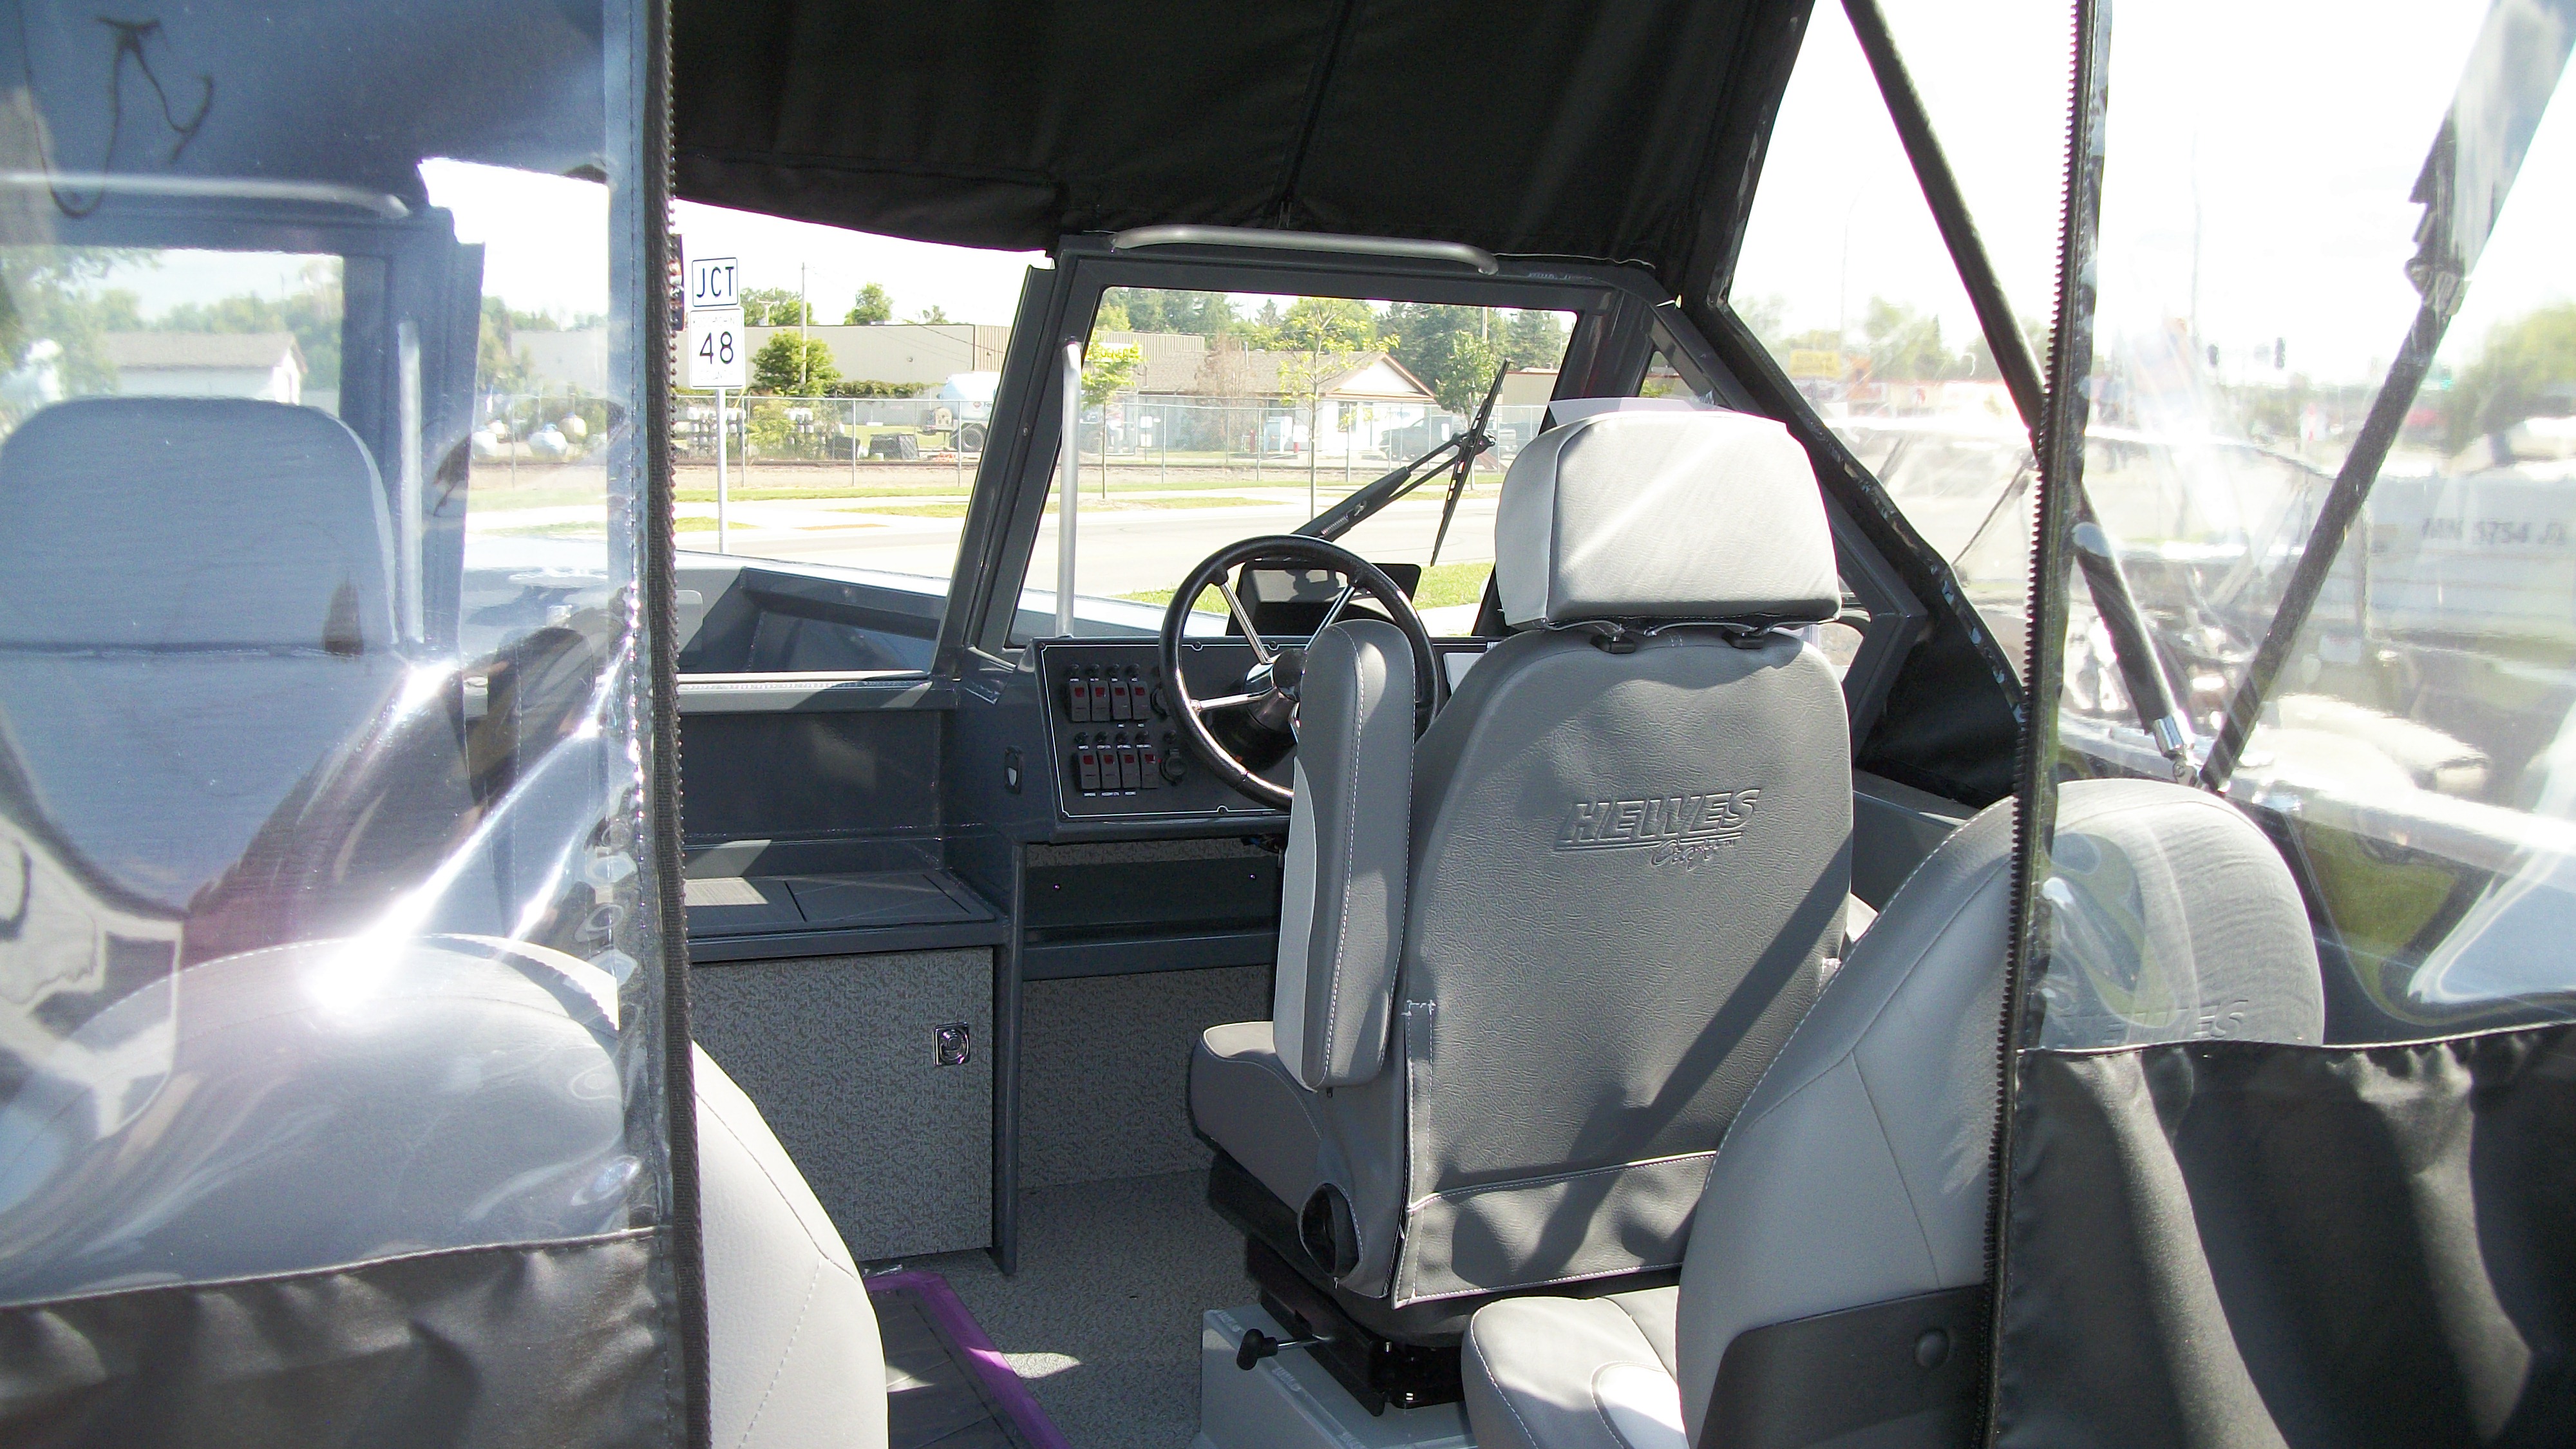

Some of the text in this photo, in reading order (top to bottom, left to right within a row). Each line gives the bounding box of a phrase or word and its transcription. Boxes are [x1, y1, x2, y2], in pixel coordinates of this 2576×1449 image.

[696, 266, 735, 298] JCT
[699, 331, 734, 365] 48
[1558, 788, 1762, 842] HEWES
